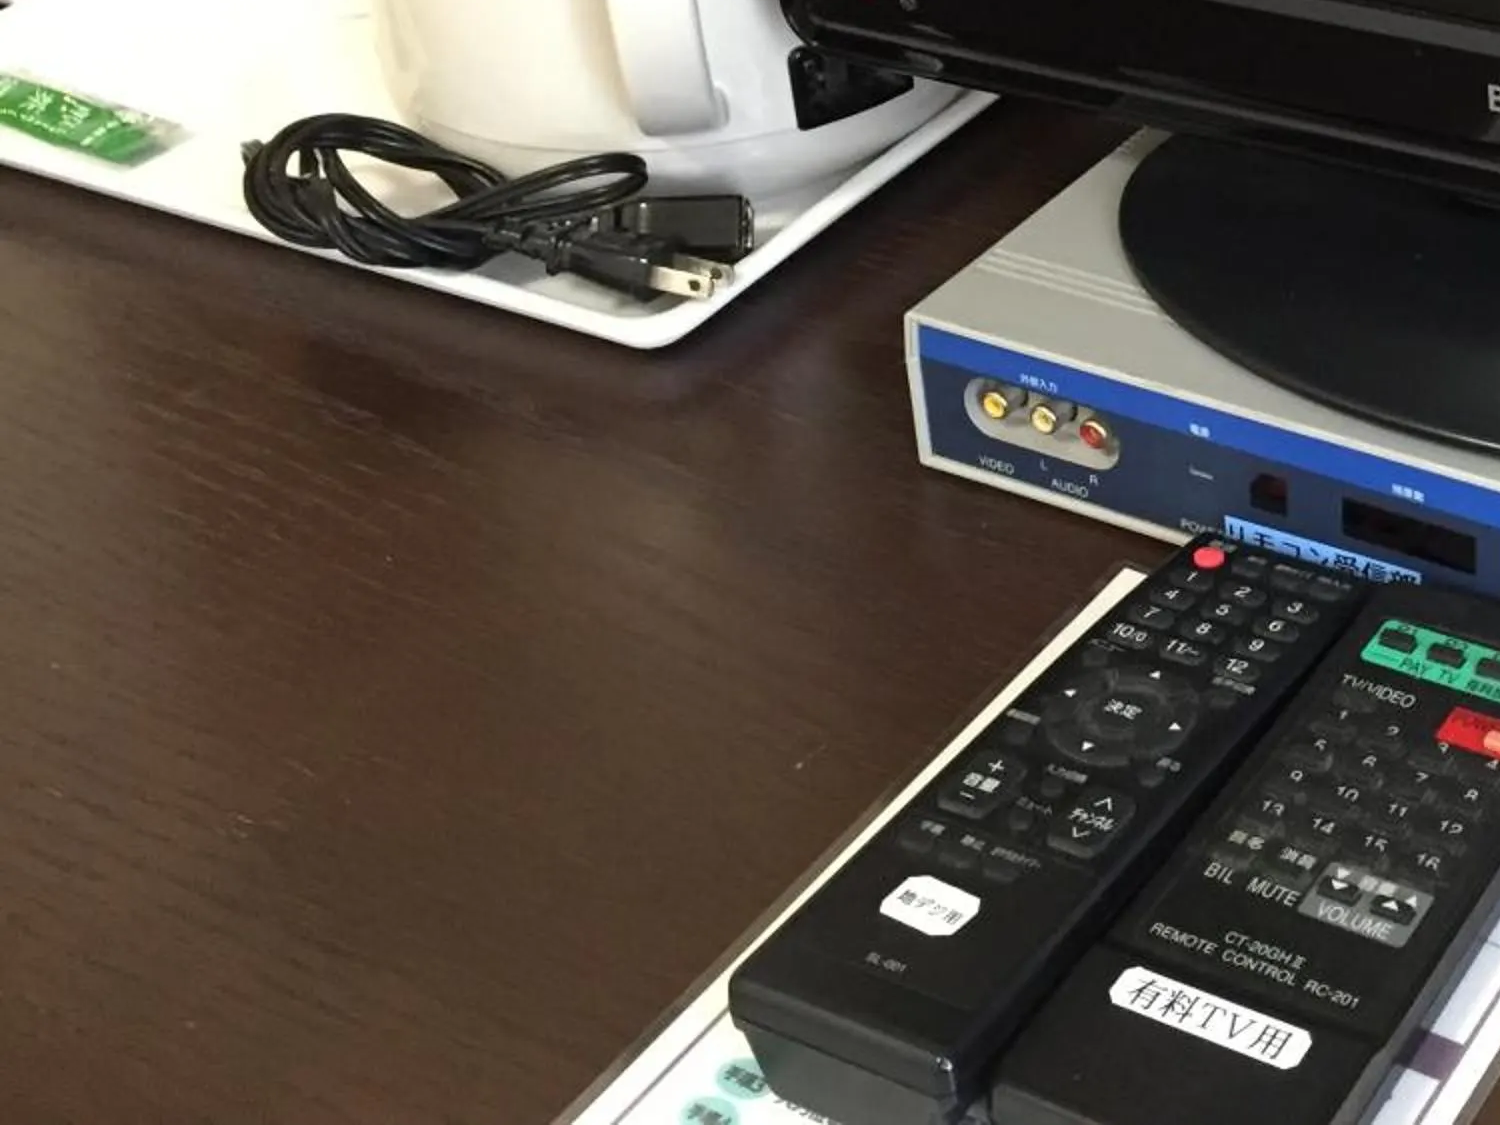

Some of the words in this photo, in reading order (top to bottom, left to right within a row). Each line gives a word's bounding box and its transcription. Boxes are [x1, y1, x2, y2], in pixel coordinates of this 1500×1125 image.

[979, 454, 1015, 475] VIDEO
[1051, 478, 1088, 498] AUDIO
[1164, 589, 1180, 600] 4
[1233, 586, 1252, 599] 2
[1143, 606, 1162, 618] 7
[1215, 603, 1232, 616] 5
[1286, 602, 1303, 614] 3
[1196, 622, 1213, 635] 8
[1268, 620, 1285, 632] 6
[1249, 639, 1265, 652] 9
[1225, 658, 1249, 674] 12
[1399, 657, 1430, 677] PAY
[1438, 668, 1459, 684] TV
[1342, 673, 1417, 709] TV/VIDEO
[1388, 803, 1408, 818] 11
[1313, 817, 1335, 835] 14
[1203, 861, 1234, 885] BIL
[1247, 876, 1301, 908] MUTE
[1317, 900, 1394, 941] VOLUME
[1149, 922, 1218, 955] REMOTE
[1221, 948, 1299, 987] CONTROL
[1303, 978, 1361, 1010] RC-201
[1127, 977, 1293, 1060] 有料TV用
